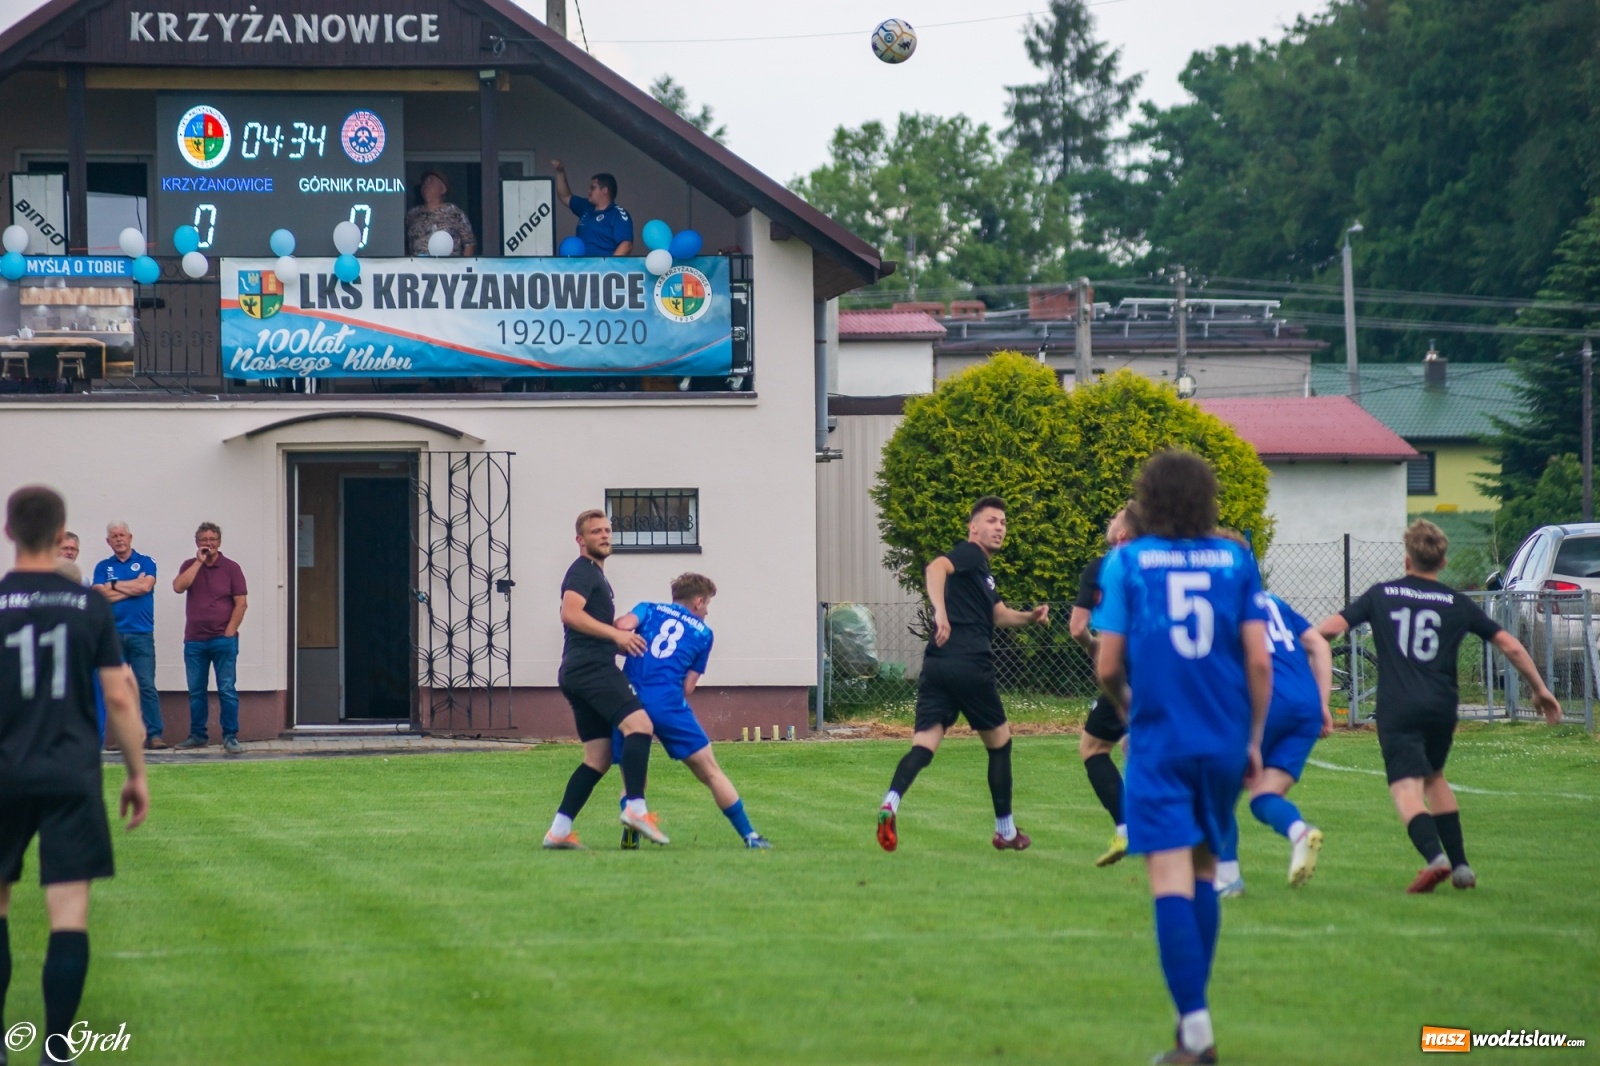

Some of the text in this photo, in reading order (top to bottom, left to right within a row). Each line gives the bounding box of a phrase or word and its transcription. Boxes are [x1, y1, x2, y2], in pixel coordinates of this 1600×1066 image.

[129, 5, 440, 44] KRZYŻANOWICE
[241, 121, 327, 159] 04:34
[162, 175, 273, 192] KRZYŻANOWICE
[298, 175, 354, 193] GÓRNIK
[15, 198, 66, 247] BINGO
[194, 203, 217, 248] 0
[505, 202, 551, 252] BINGO
[27, 256, 126, 275] MYŚLĄ O TOBIE
[300, 266, 647, 310] LKS KRZYŻANOWICE
[496, 318, 648, 346] 1920-2020
[229, 345, 413, 377] Naszego Klubu
[1166, 571, 1214, 660] 5
[1390, 606, 1442, 663] 16
[651, 618, 685, 659] 8
[5, 624, 68, 700] 11
